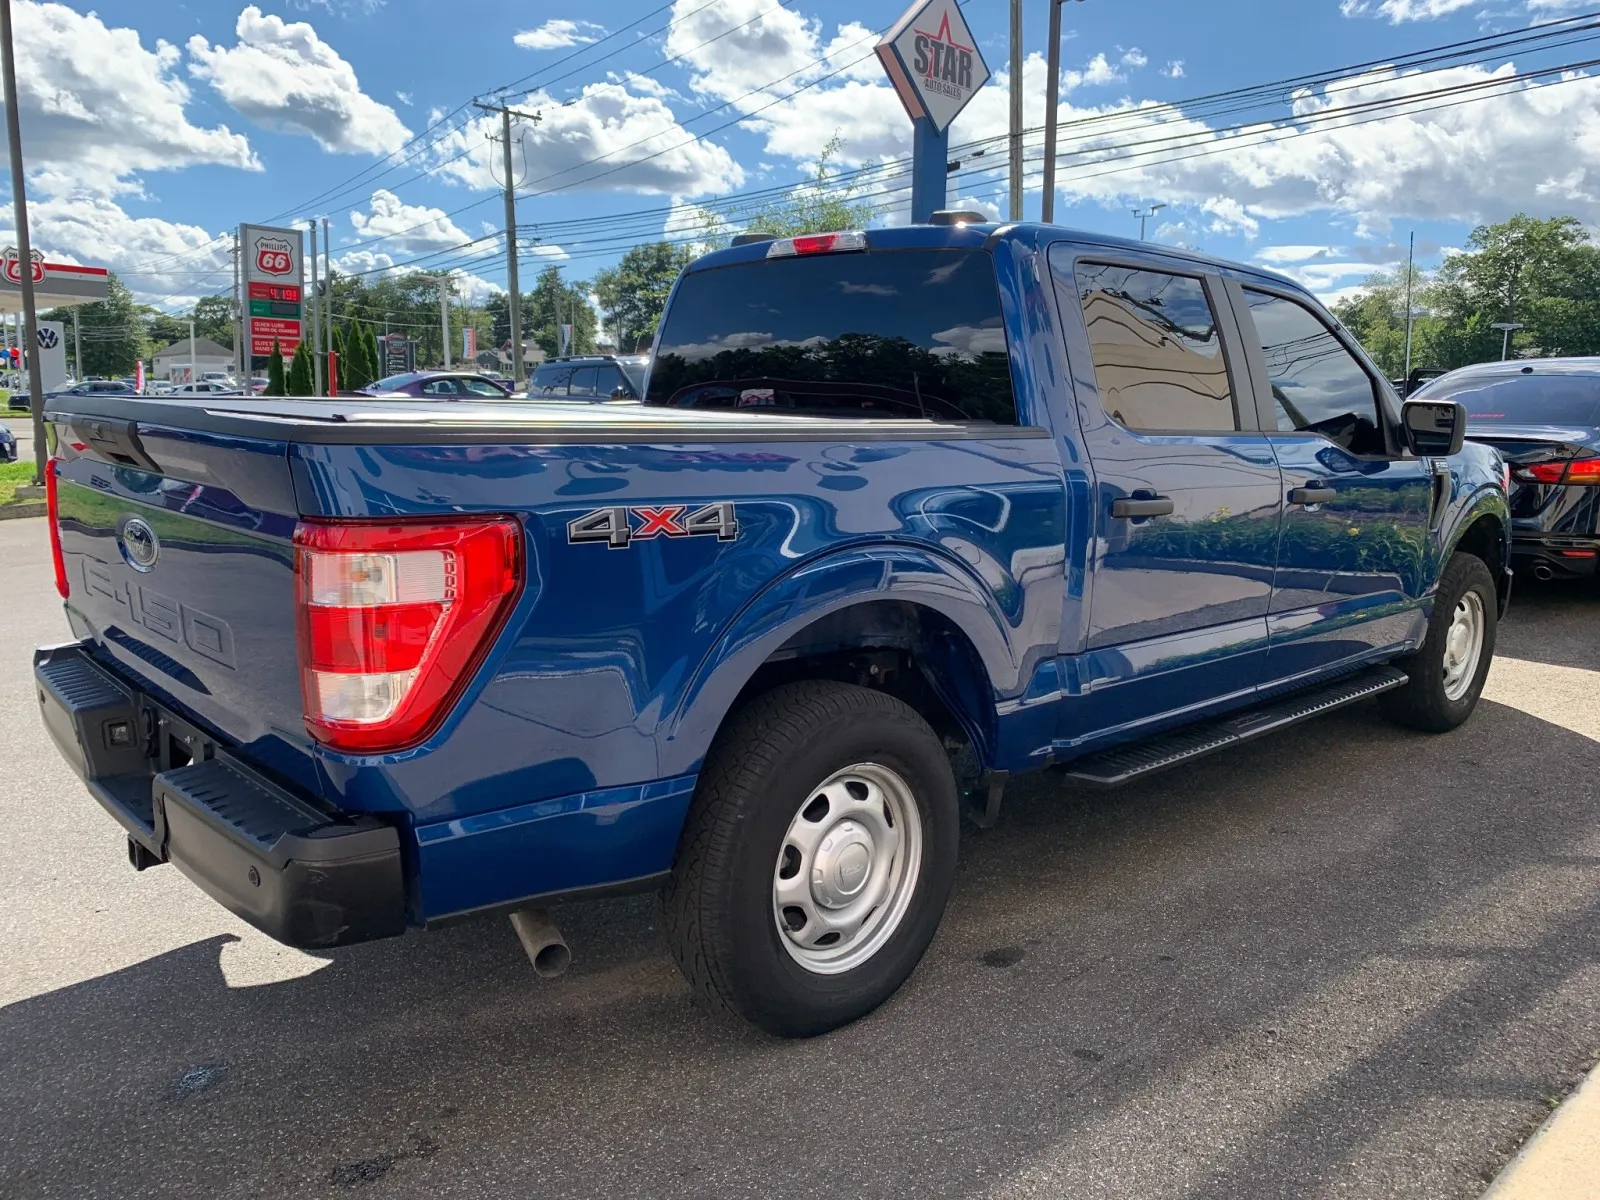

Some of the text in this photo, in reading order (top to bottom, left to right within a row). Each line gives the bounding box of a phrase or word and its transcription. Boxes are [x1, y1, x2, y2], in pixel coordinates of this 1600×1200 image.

[914, 35, 972, 88] STAR
[925, 78, 961, 98] AUTO SALES
[260, 242, 288, 251] PHILLIPS
[9, 252, 39, 260] PHPS
[262, 253, 287, 269] 66
[81, 556, 237, 672] F-150
